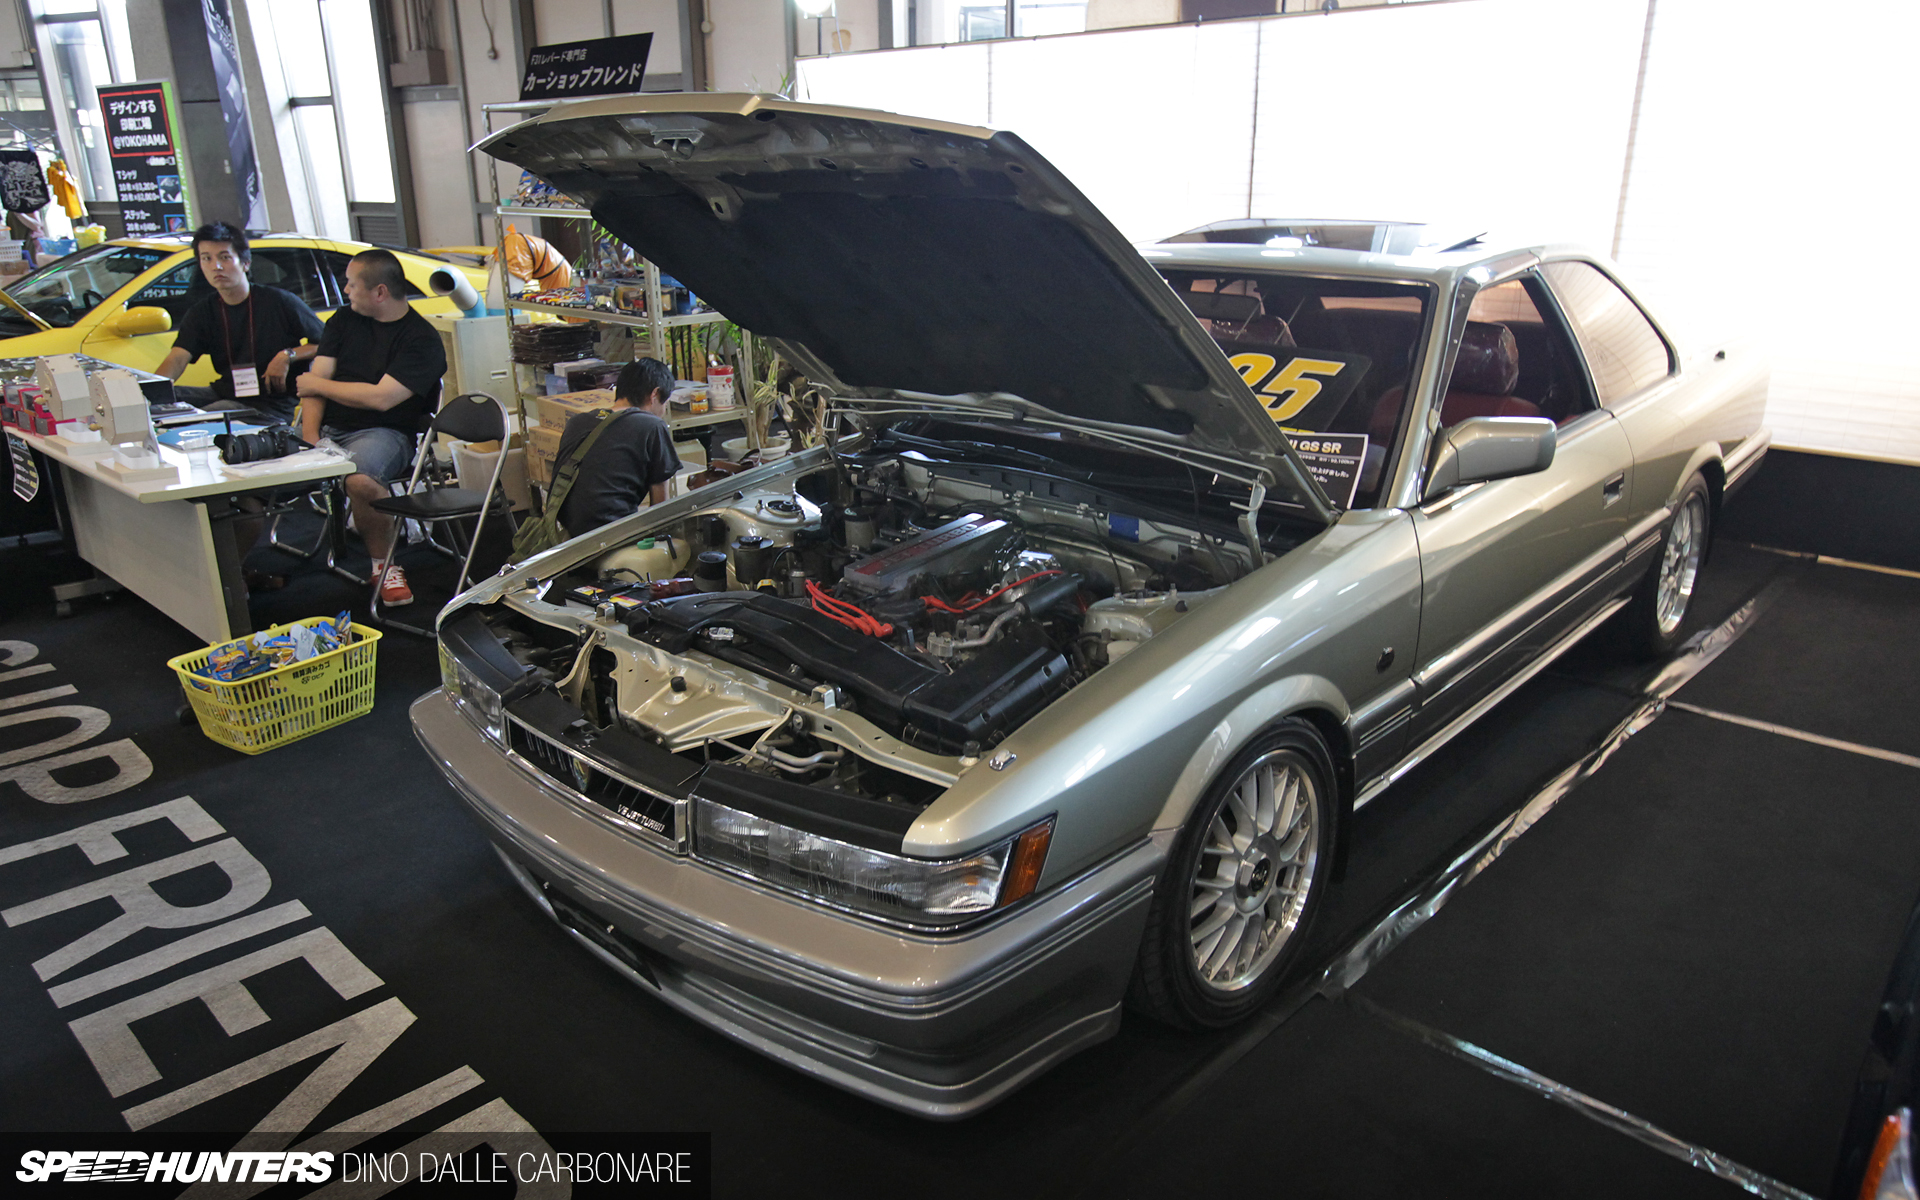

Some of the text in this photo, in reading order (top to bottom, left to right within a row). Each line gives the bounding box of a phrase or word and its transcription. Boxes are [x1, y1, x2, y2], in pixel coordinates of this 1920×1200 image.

[523, 63, 642, 92] カーショップフレンド
[109, 99, 157, 116] デザインする
[113, 133, 168, 149] @YOKOHAMA
[1299, 440, 1320, 452] GS
[1321, 441, 1342, 454] SR
